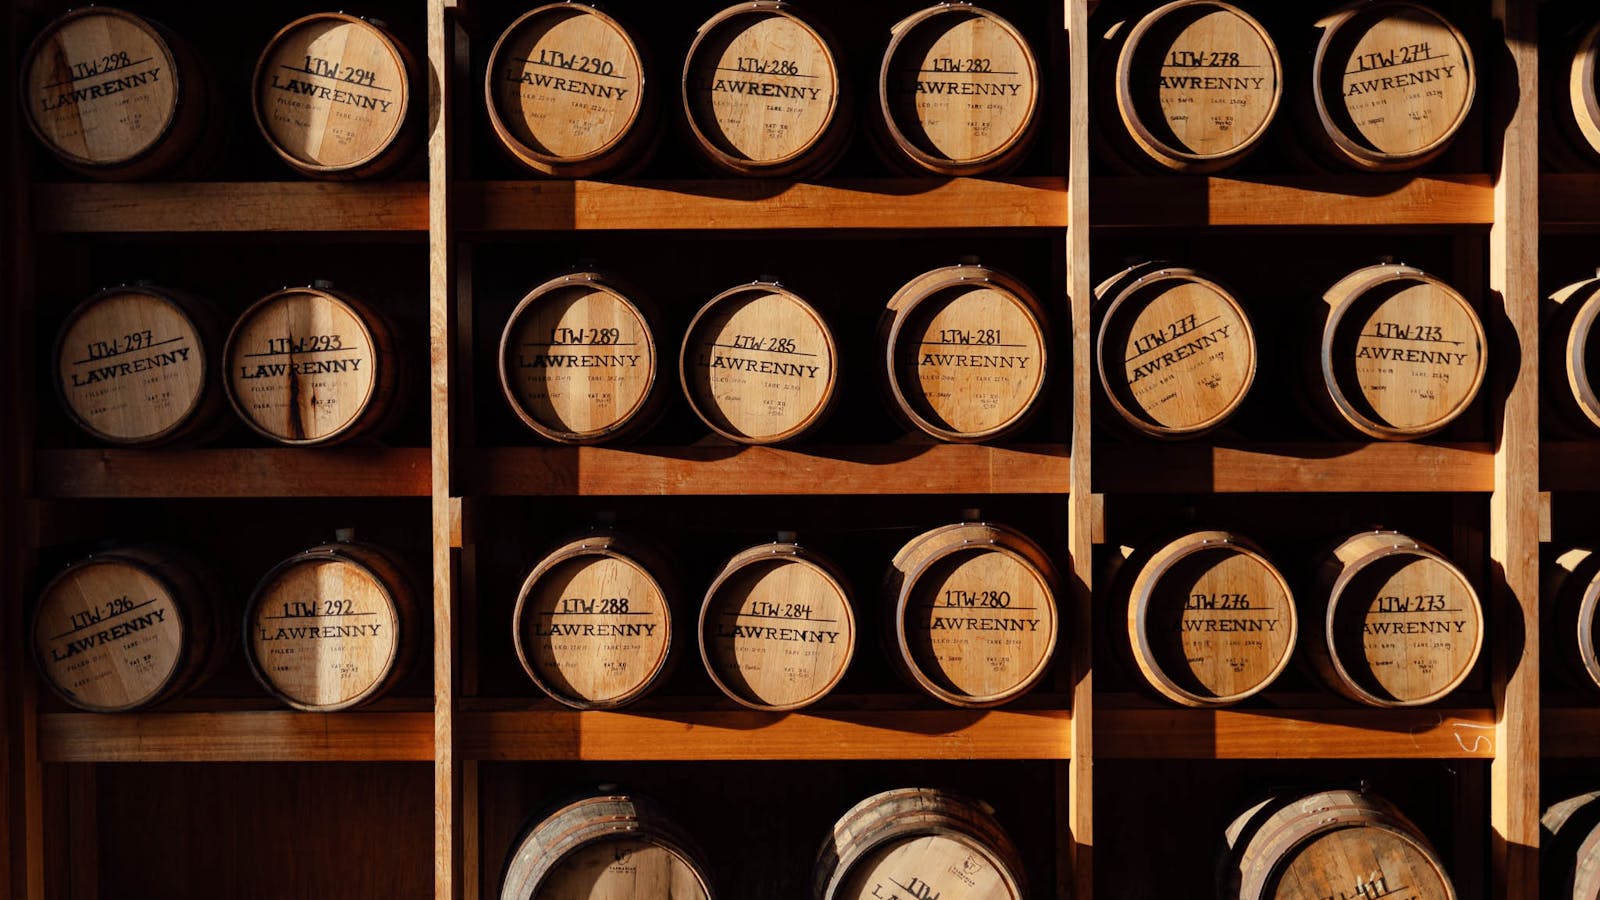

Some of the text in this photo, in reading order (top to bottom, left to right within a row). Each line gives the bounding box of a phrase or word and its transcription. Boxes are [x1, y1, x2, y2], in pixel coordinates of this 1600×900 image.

[68, 51, 131, 79] LTW-298
[540, 49, 613, 76] LTW-290
[933, 58, 992, 72] LTW-282
[1171, 51, 1240, 68] LTW-278
[1356, 41, 1431, 71] LTW-274
[304, 55, 376, 87] LTW-294
[738, 57, 799, 76] LTW-286
[41, 67, 161, 112] LAWRENNY
[506, 69, 628, 101] LAWRENNY
[913, 80, 1022, 96] AWRENNY
[1158, 76, 1264, 90] AWRENNY
[1343, 65, 1456, 97] AWRENNY
[271, 75, 393, 113] LAWRENNY
[551, 327, 620, 345] LTW-289
[940, 329, 1001, 345] LTW-281
[1134, 314, 1197, 355] LTW-277
[1375, 322, 1443, 342] LTW-273
[87, 330, 152, 360] LTW-297
[733, 335, 796, 353] LTW-285
[519, 355, 640, 368] LAWRENNY
[1128, 324, 1230, 385] AWRENNY
[1357, 346, 1469, 366] AWRENNY
[71, 347, 190, 387] LAWRENNY
[241, 358, 362, 379] LAWRENNY
[698, 354, 820, 379] LAWRENNY
[282, 599, 354, 618] LTW-292
[562, 598, 630, 614] LTW-288
[945, 590, 1010, 609] LTW-280
[1378, 595, 1446, 613] LTW-273
[70, 595, 134, 631] LTW-296
[751, 601, 813, 620] LTW-284
[51, 608, 165, 662] LAWRENNY
[260, 624, 381, 641] LAWRENNY
[535, 624, 657, 637] LAWRENNY
[1361, 620, 1467, 635] AWRENNY
